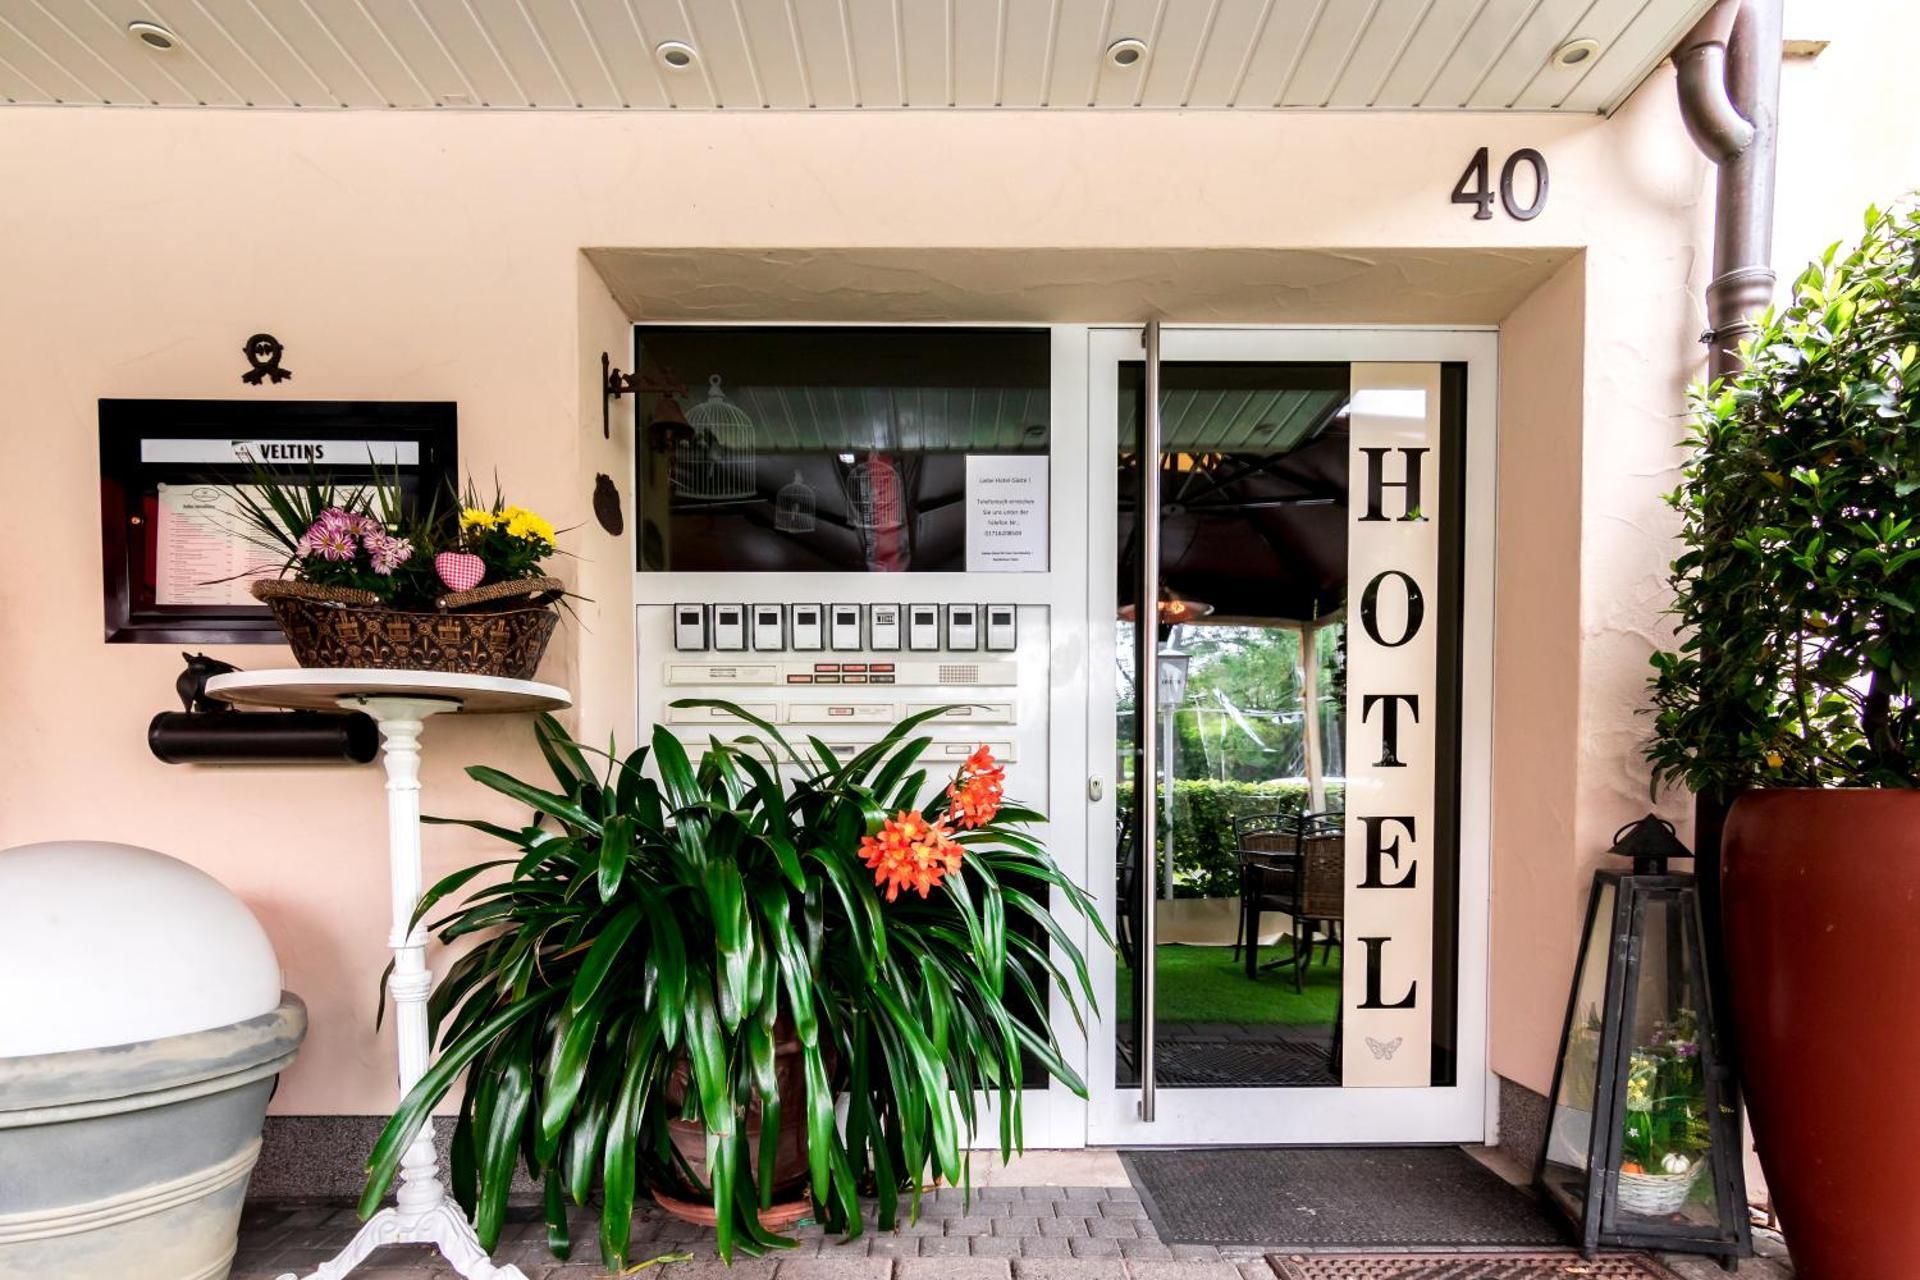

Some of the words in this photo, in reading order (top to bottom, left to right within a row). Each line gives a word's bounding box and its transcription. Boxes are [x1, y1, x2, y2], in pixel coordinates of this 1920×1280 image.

[1451, 147, 1549, 221] 40
[261, 444, 324, 459] VELTINS
[1356, 448, 1431, 1009] HOTEL
